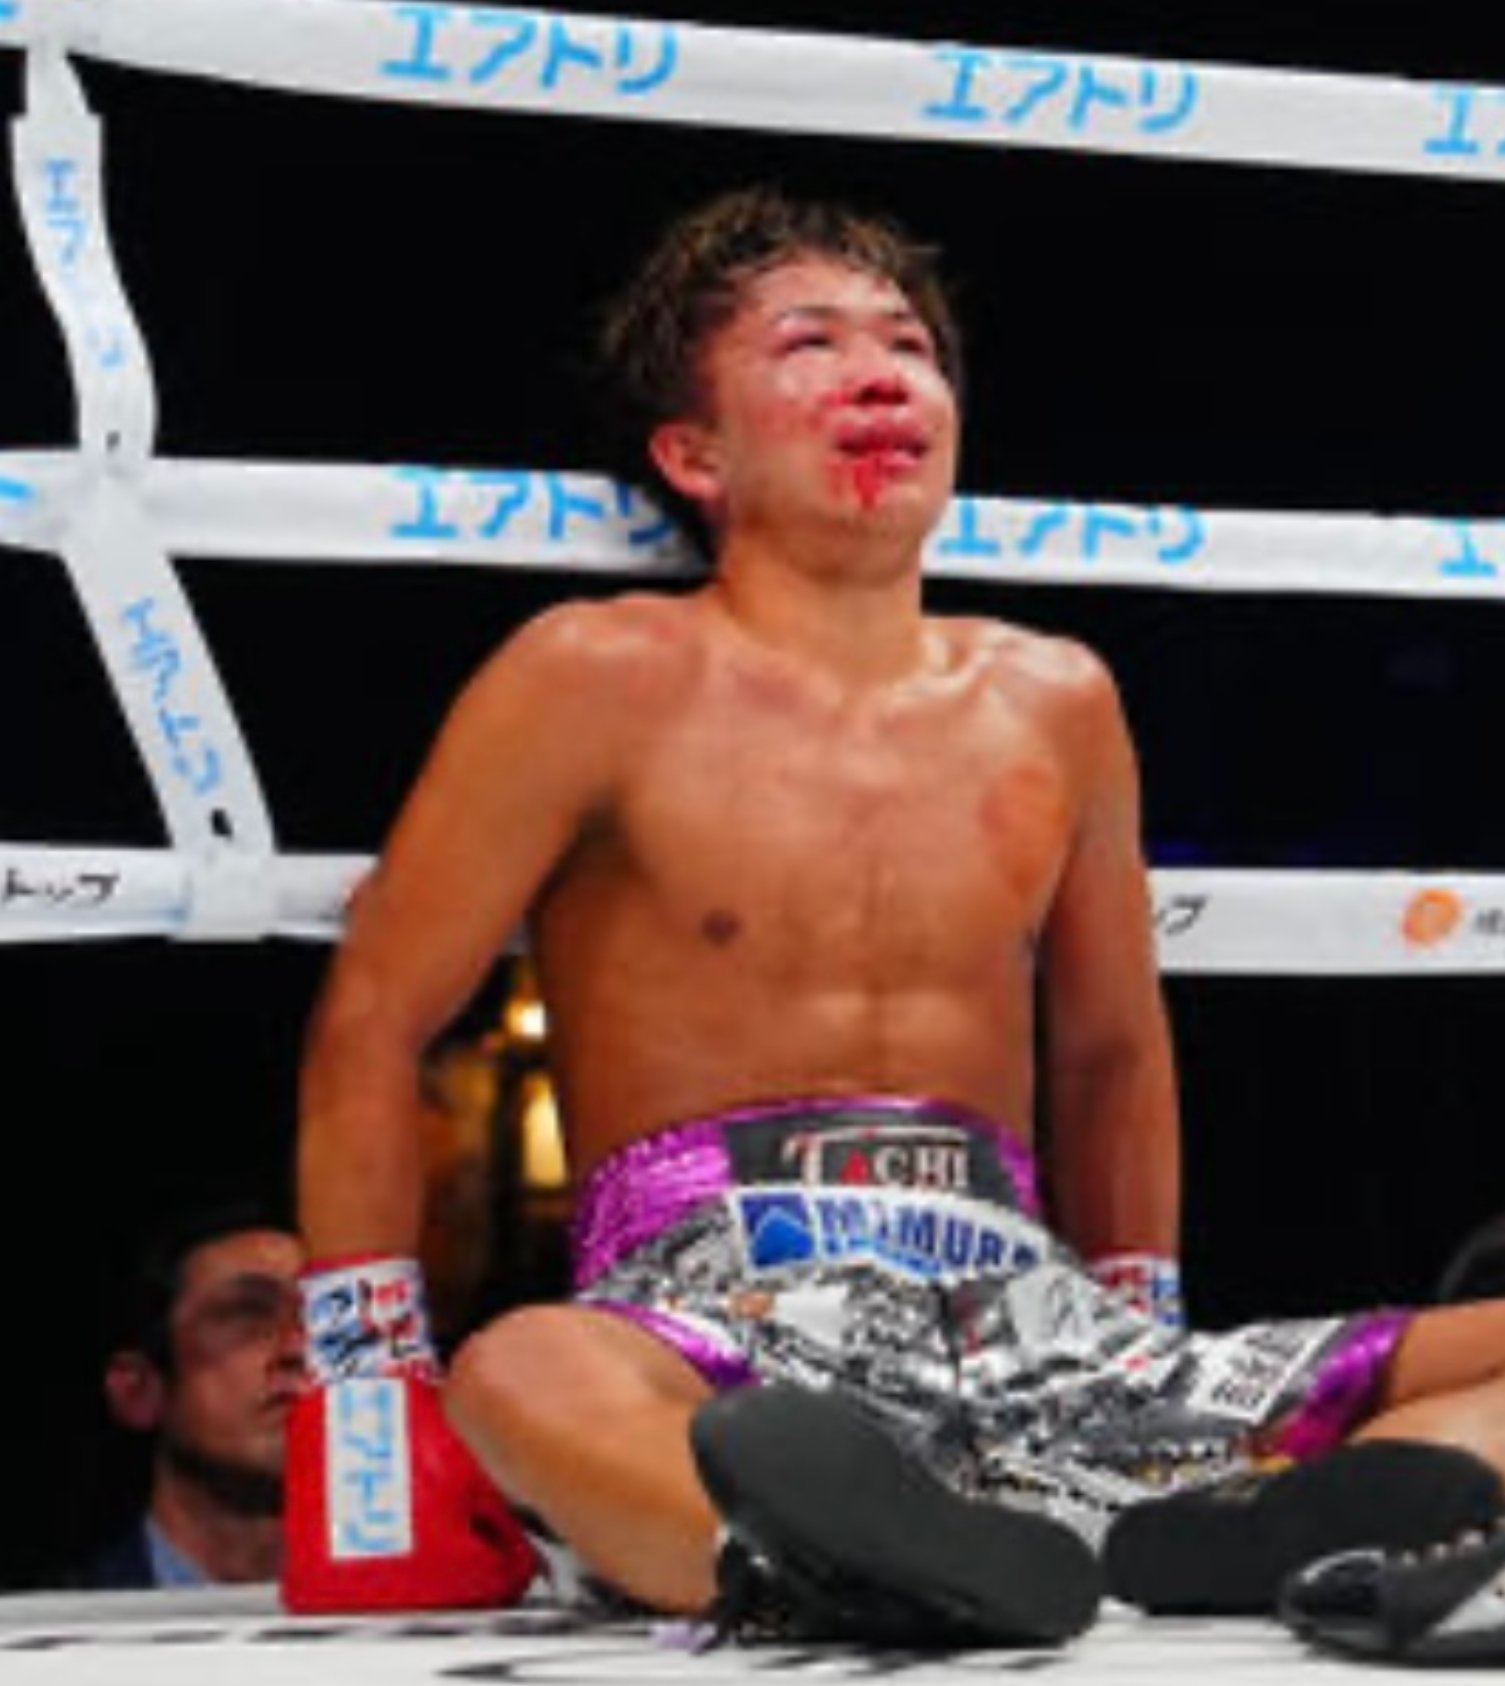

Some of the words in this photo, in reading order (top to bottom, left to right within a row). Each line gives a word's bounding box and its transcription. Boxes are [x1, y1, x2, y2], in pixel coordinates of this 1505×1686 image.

[381, 6, 679, 93] エアトリ
[921, 48, 1199, 136] エアトリ
[936, 498, 1206, 562] エアトリ
